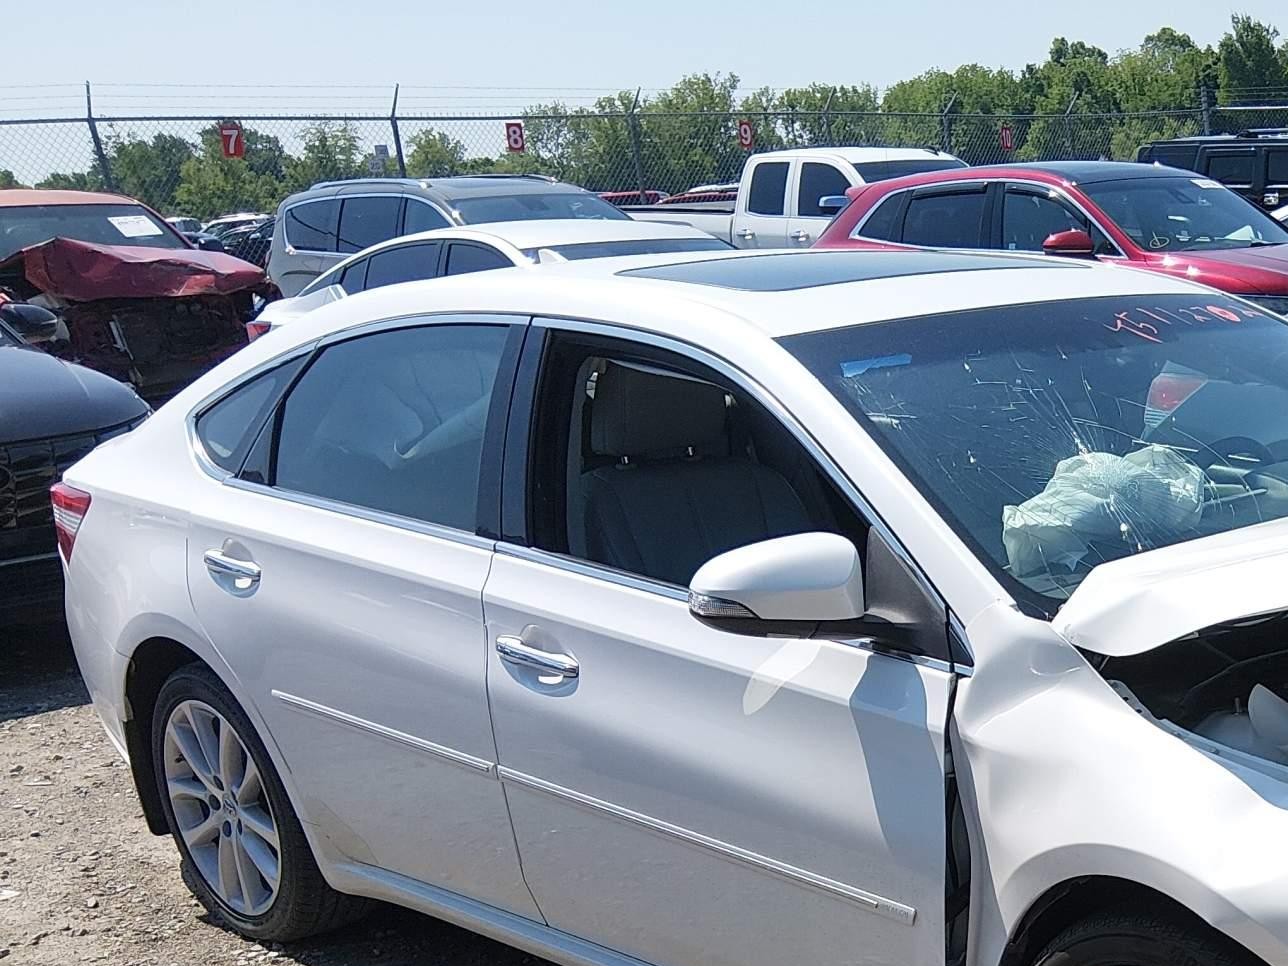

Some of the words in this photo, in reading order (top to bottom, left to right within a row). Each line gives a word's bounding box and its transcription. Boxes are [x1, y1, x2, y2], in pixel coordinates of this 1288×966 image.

[222, 129, 239, 154] 7
[508, 126, 523, 149] 8
[740, 124, 752, 145] 9
